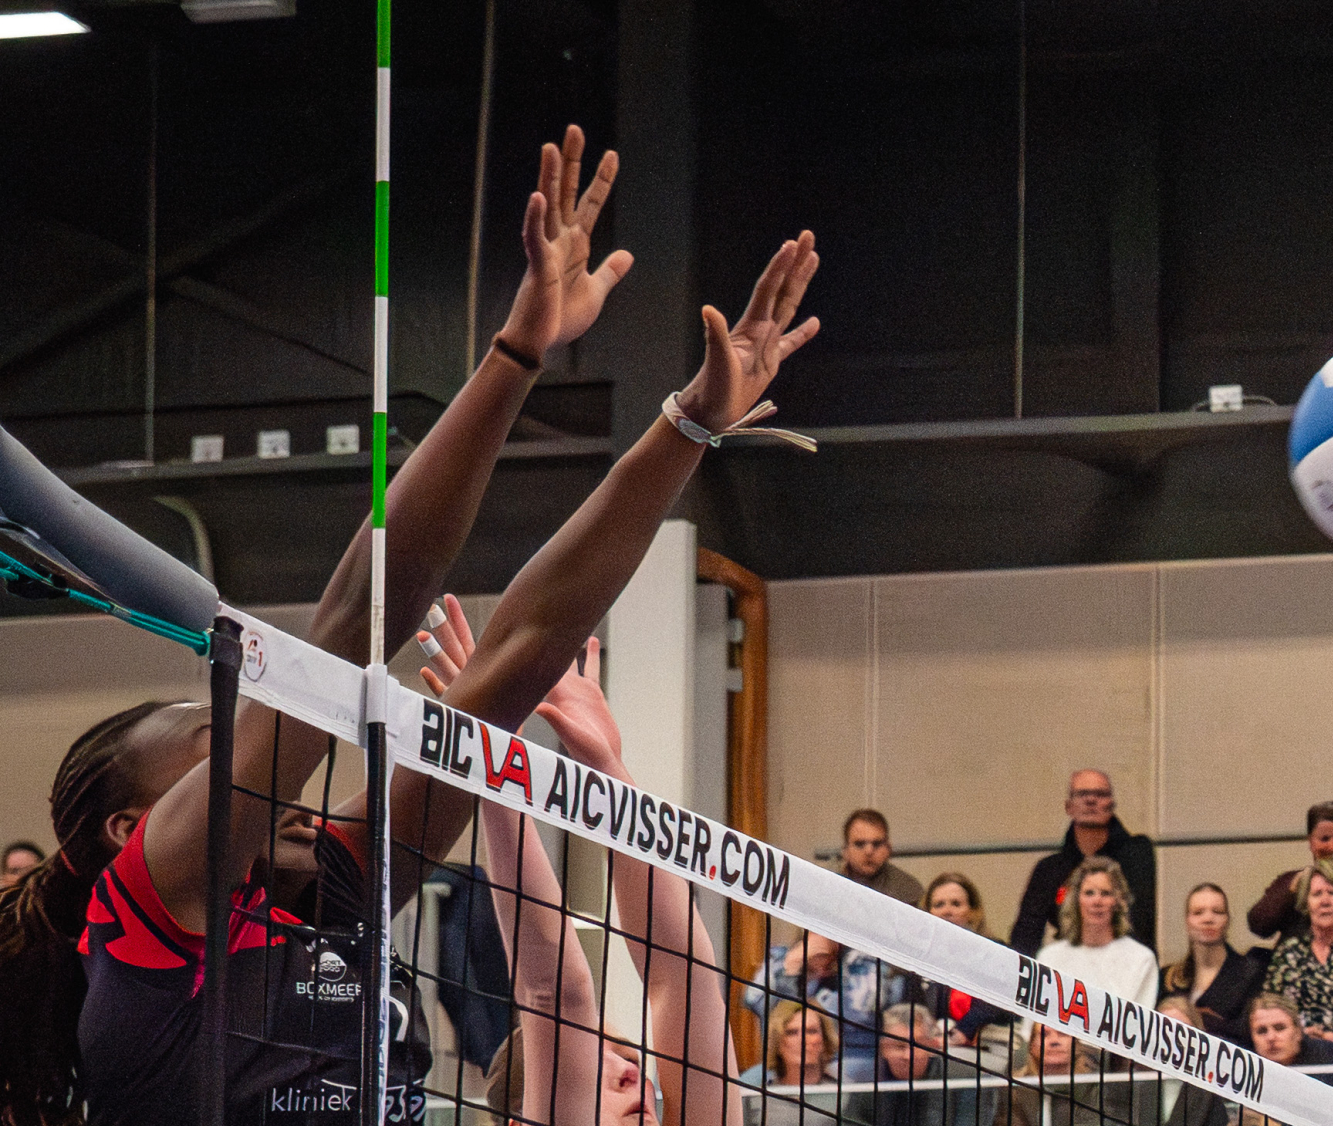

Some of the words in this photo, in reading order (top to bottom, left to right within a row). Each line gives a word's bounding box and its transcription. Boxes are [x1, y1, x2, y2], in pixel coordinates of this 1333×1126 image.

[543, 755, 791, 910] AICVISSER.COM
[270, 1087, 354, 1113] kliniek
[1096, 991, 1265, 1103] AICVISSER.COM
